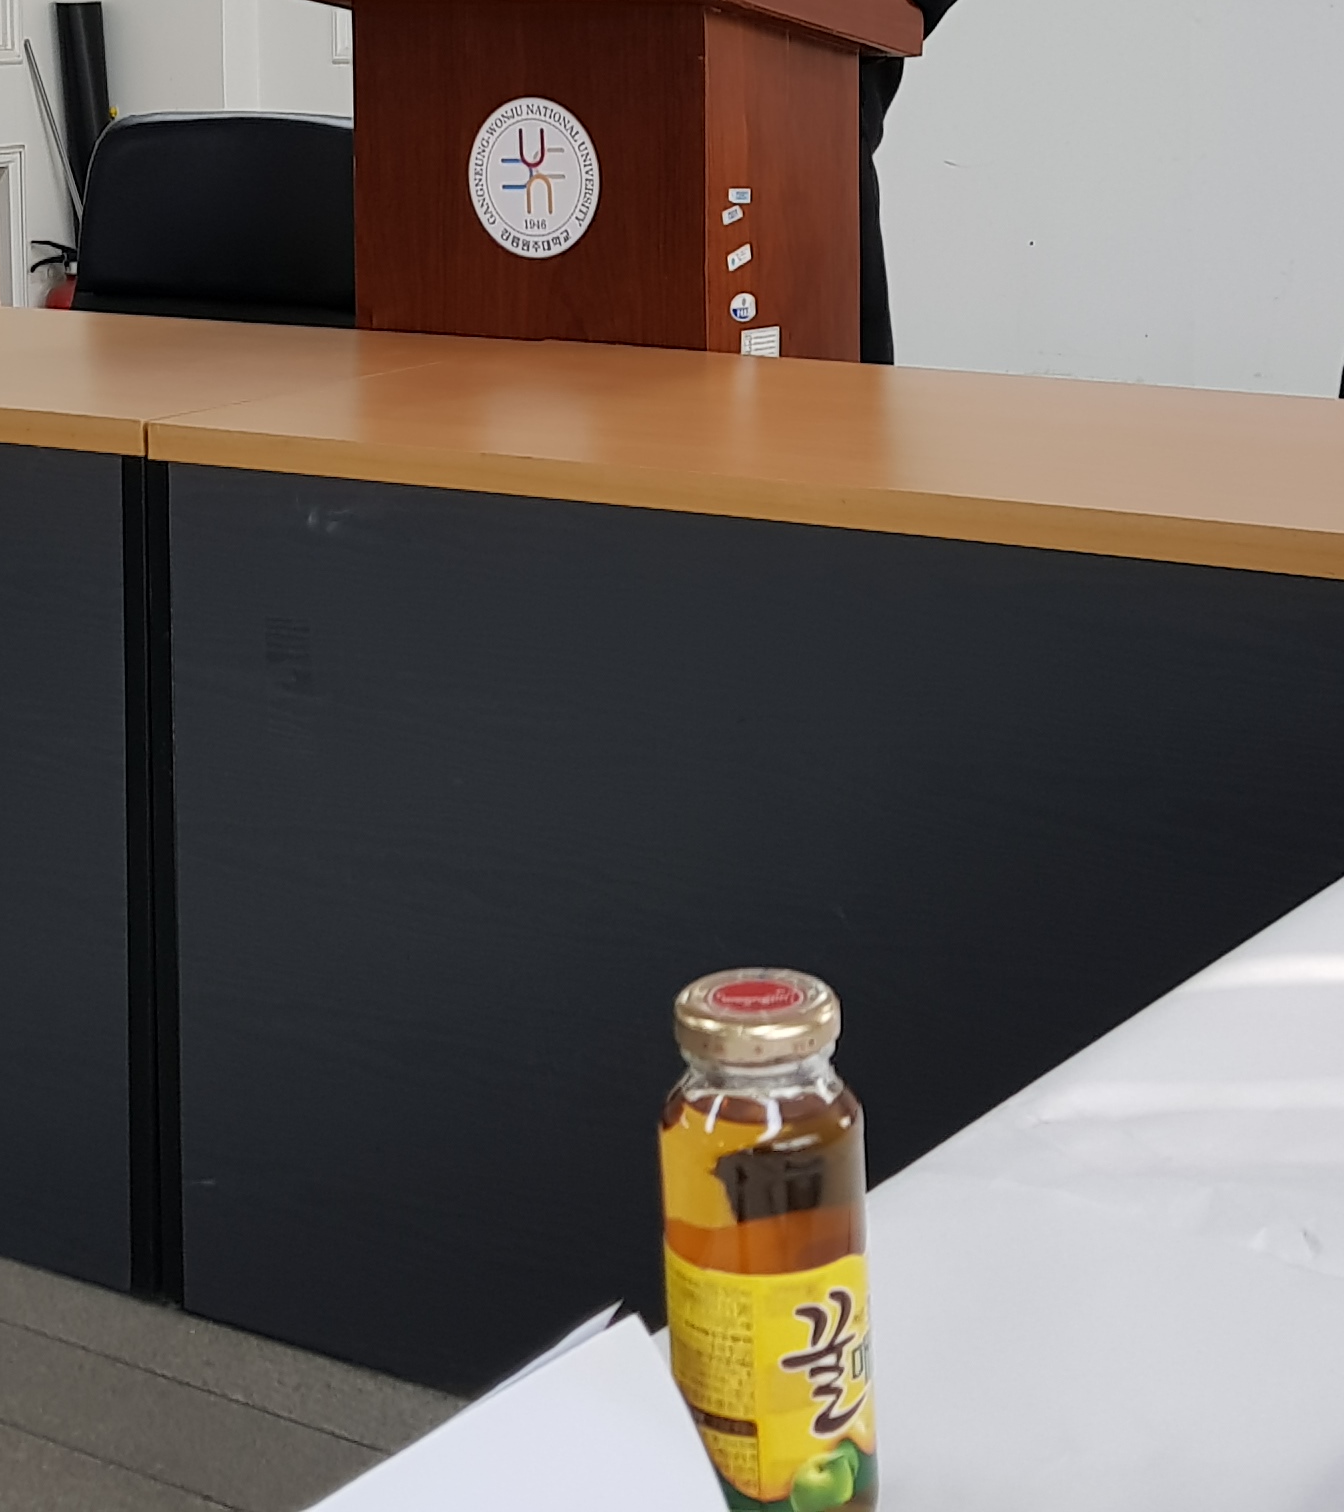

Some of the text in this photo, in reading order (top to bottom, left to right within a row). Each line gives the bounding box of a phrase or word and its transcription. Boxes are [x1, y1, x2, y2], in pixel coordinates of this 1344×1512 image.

[474, 103, 595, 228] GANGNEUNG-WONJU NATIONAL UNIVERSITY
[524, 218, 547, 230] 1946
[781, 1290, 868, 1434] 꿀
